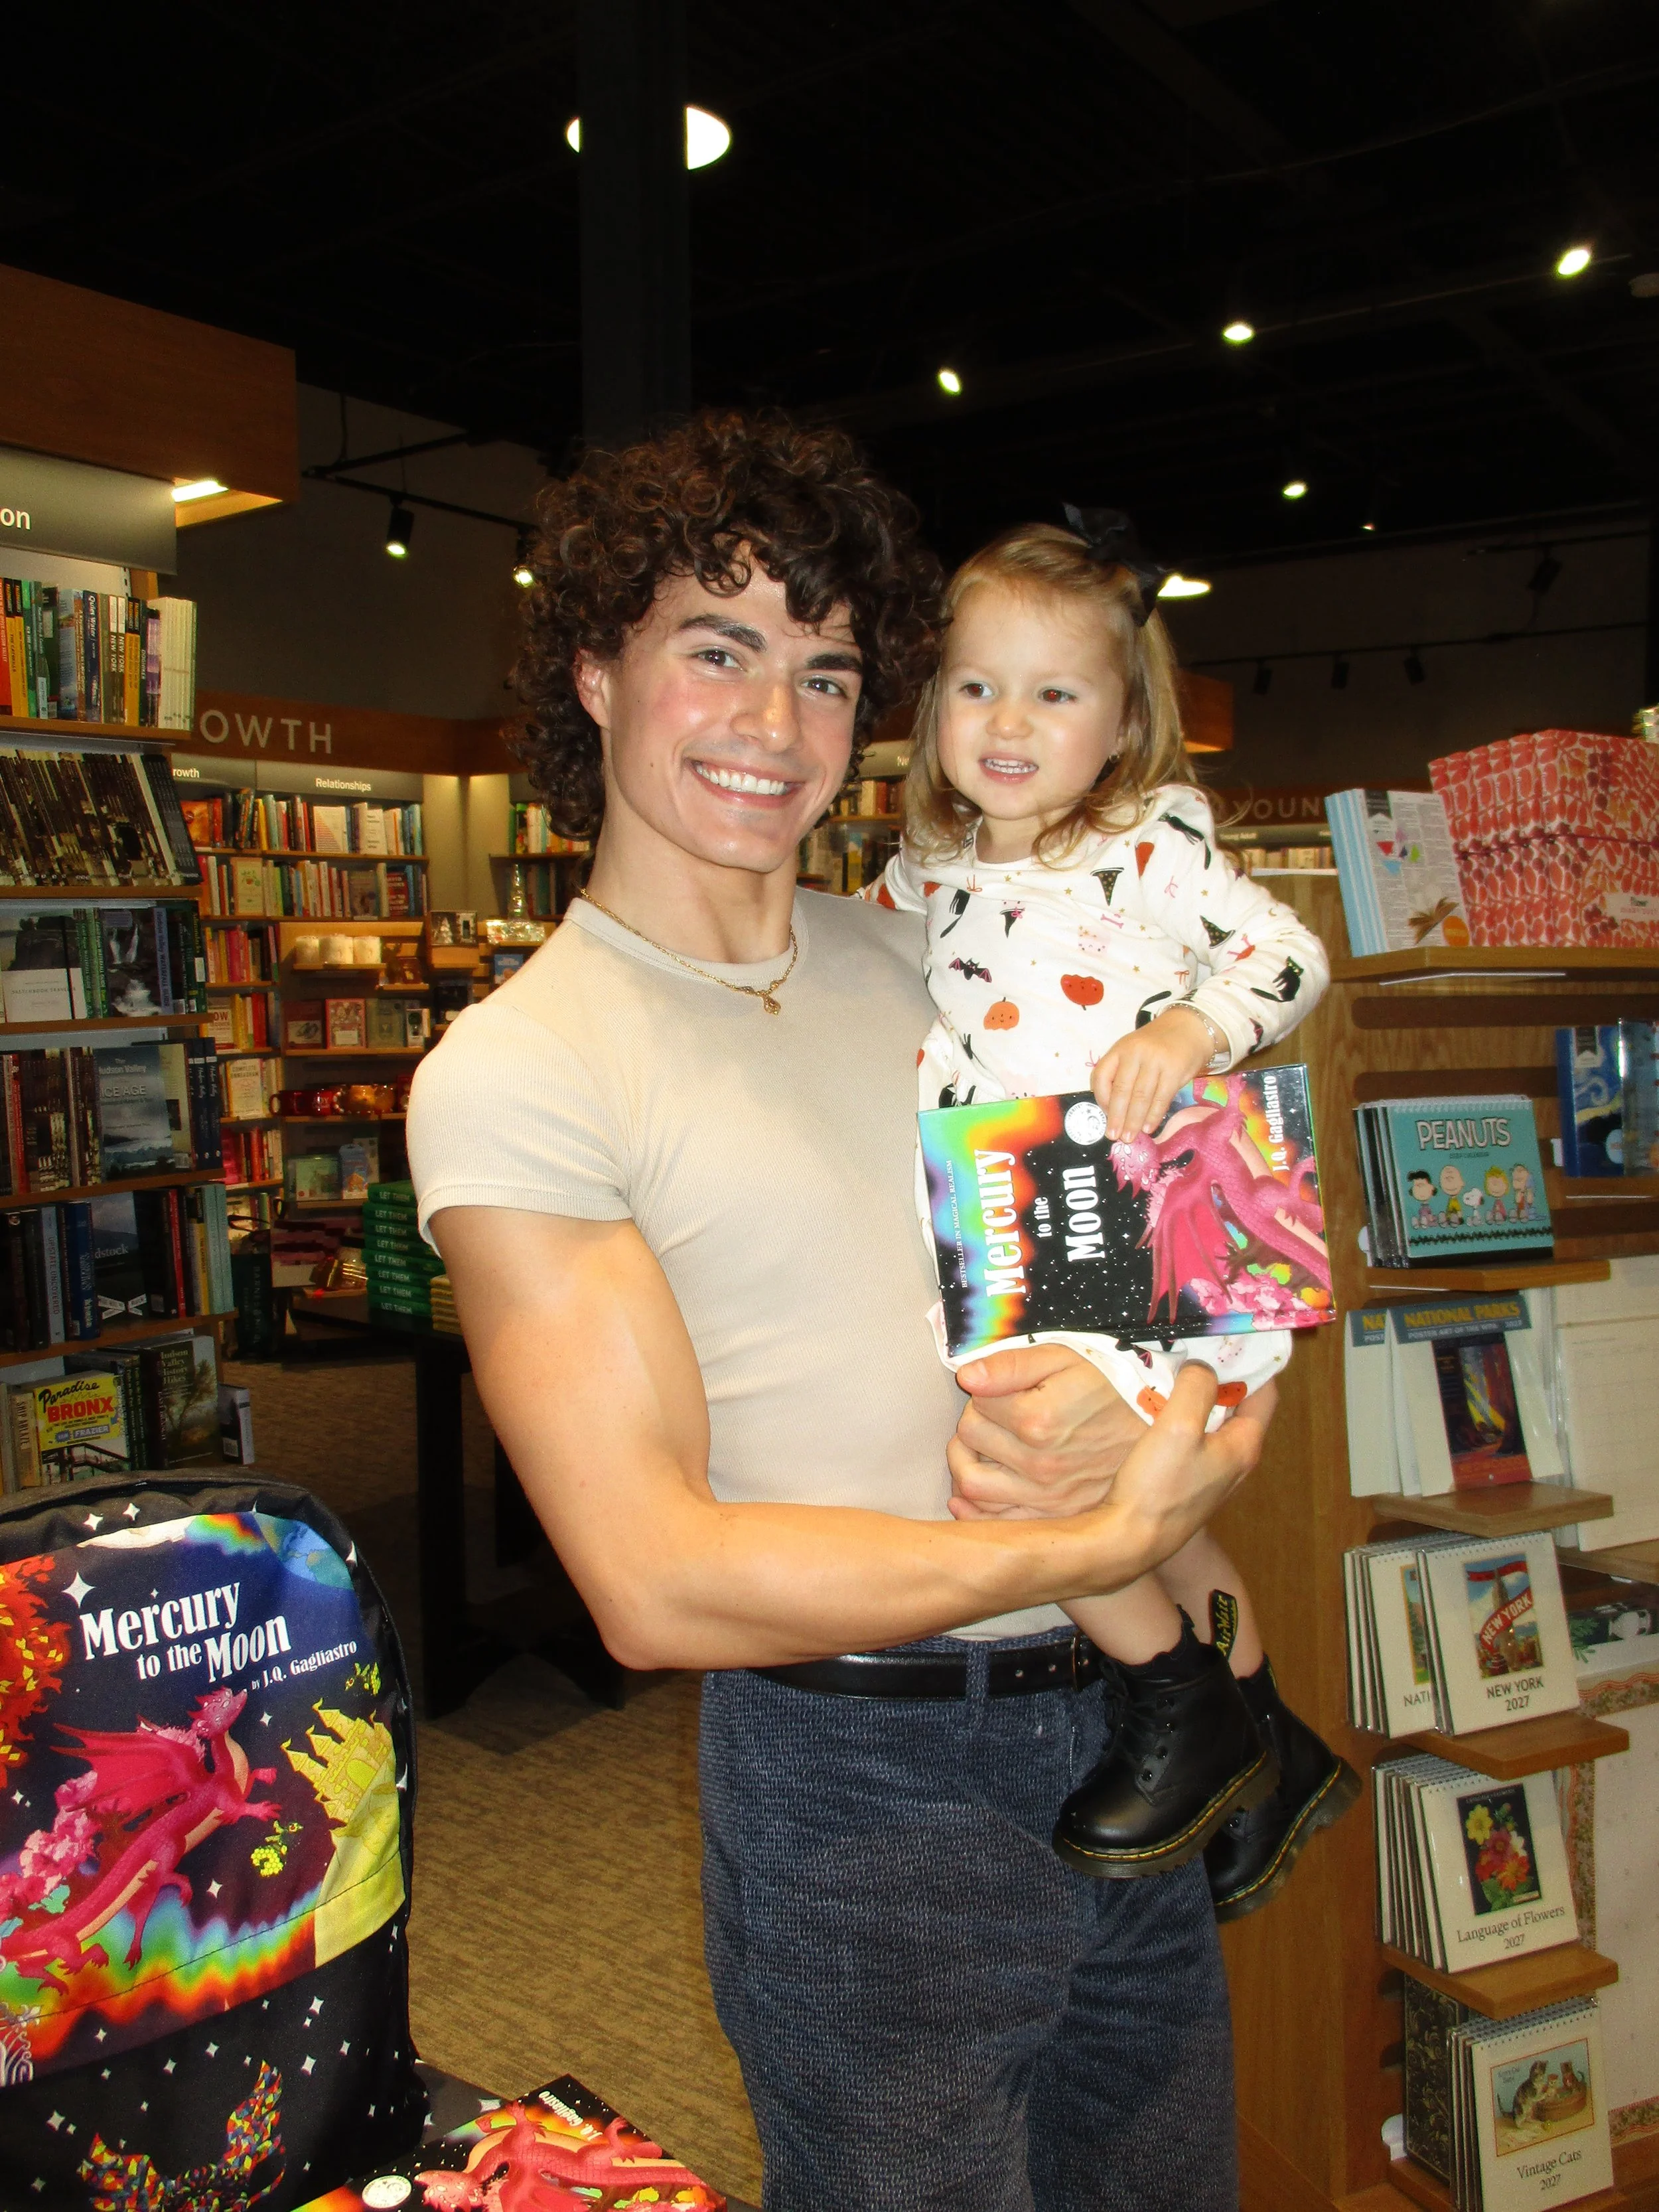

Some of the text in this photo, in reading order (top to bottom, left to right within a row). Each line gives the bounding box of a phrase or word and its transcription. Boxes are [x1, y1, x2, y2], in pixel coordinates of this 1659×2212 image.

[1, 508, 31, 530] on
[200, 709, 332, 754] OWTH
[173, 768, 199, 778] rowth
[315, 778, 371, 792] Relationships
[1233, 796, 1321, 819] YOUN
[125, 1064, 147, 1073] Valley
[123, 1085, 147, 1096] AGE
[1262, 1074, 1289, 1172] J.Q. Gagliastro
[1415, 1117, 1511, 1151] PEANUTS
[946, 1159, 968, 1288] BESTSELLER IN MAGICAL REALISM
[974, 1149, 1026, 1297] Mercury
[1033, 1195, 1052, 1238] to the
[1062, 1165, 1106, 1262] Moon
[95, 1243, 129, 1259] dstock
[374, 1254, 386, 1263] LET
[392, 1272, 409, 1282] THEM
[393, 1287, 412, 1297] THEM
[1404, 1307, 1474, 1327] NATIONAL
[1474, 1301, 1521, 1319] PARKS
[1364, 1333, 1385, 1343] POST
[1407, 1329, 1439, 1339] POSTER
[38, 1380, 99, 1414] Paradise
[16, 1401, 27, 1418] SHIP
[46, 1396, 114, 1423] BRONX
[74, 1426, 109, 1438] FRAZIER
[79, 1582, 241, 1660] Mercury
[1482, 1593, 1532, 1645] NEW YORK
[137, 1615, 292, 1683] to the Moon
[252, 1639, 358, 1690] by J.Q. Gagliastro
[1404, 1691, 1431, 1707] NATI
[1486, 1676, 1544, 1700] NEW YORK
[1505, 1695, 1530, 1712] 2027
[1457, 1905, 1565, 1943] Language of Flowers
[1503, 1933, 1525, 1950] 2027
[538, 2091, 603, 2141] J.Q. Gagliastro
[1516, 2149, 1583, 2179] Vintage Cats
[1539, 2174, 1561, 2191] 2027
